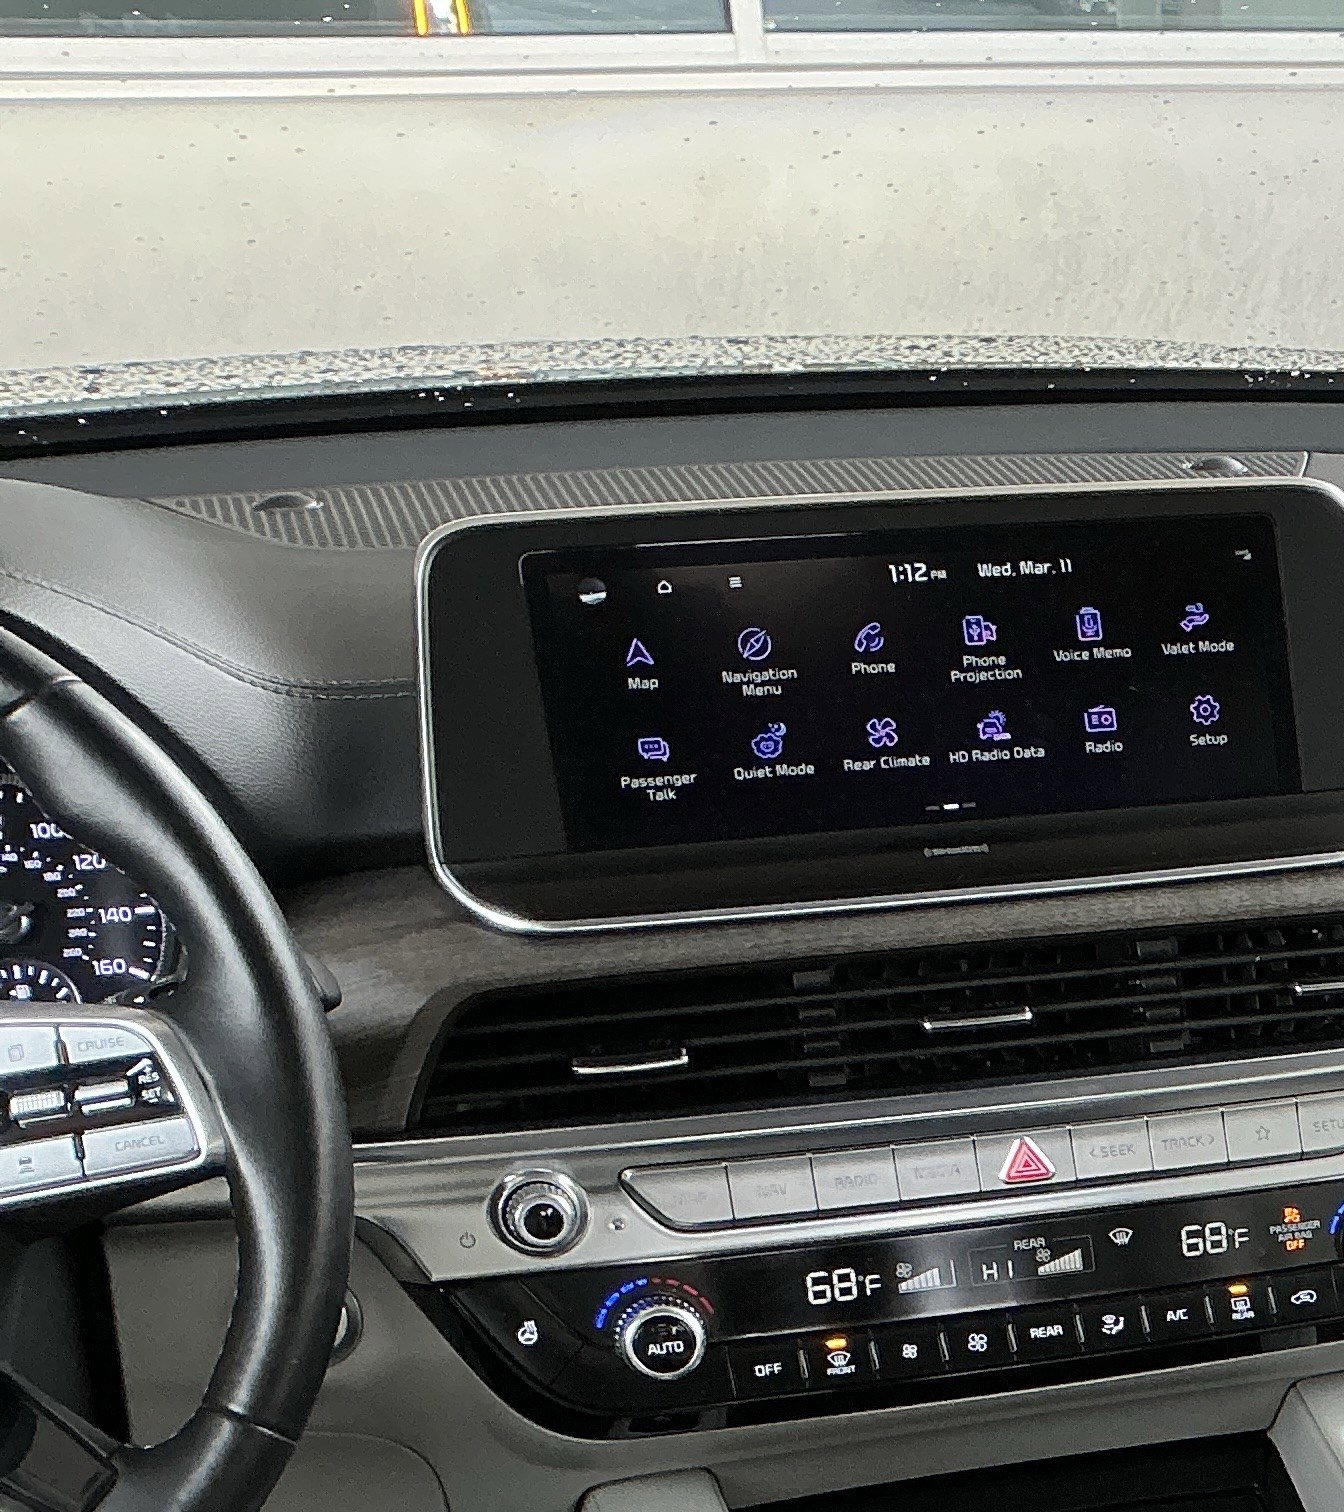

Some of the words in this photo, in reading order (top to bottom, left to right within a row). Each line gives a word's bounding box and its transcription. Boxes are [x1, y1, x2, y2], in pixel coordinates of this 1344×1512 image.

[889, 562, 929, 584] 1:12
[977, 562, 1017, 578] Wed.
[1019, 560, 1056, 576] Mar.
[1060, 558, 1073, 574] 11
[1053, 648, 1090, 662] Voice
[1093, 646, 1132, 659] Memo
[1161, 642, 1197, 656] Valet
[1199, 639, 1235, 653] Mode
[851, 661, 896, 675] Phone
[963, 654, 1006, 667] Phone
[722, 667, 798, 685] Navigation
[950, 667, 1022, 684] Projection
[628, 677, 659, 692] Map
[742, 683, 782, 697] Menu
[1085, 740, 1123, 754] Radio
[1189, 733, 1228, 748] Setup
[843, 758, 876, 771] Rear
[880, 754, 931, 769] Climate
[949, 751, 969, 764] HD
[972, 747, 1010, 761] Radio
[1013, 746, 1045, 759] Data
[734, 765, 774, 782] Quiet
[776, 762, 815, 777] Mode
[621, 772, 698, 790] Passenger
[646, 787, 677, 802] Talk
[29, 822, 64, 839] 100
[72, 854, 106, 871] 120
[98, 906, 133, 924] 140
[91, 958, 126, 976] 160
[77, 1037, 125, 1052] CRUISE
[138, 1072, 160, 1085] RES
[114, 1135, 165, 1152] CANCEL
[1013, 1237, 1046, 1251] REAR
[1285, 1239, 1305, 1250] OFF
[1166, 1308, 1189, 1322] A/C
[1030, 1324, 1064, 1339] REAR
[647, 1340, 684, 1356] AUTO
[754, 1362, 782, 1377] OFF
